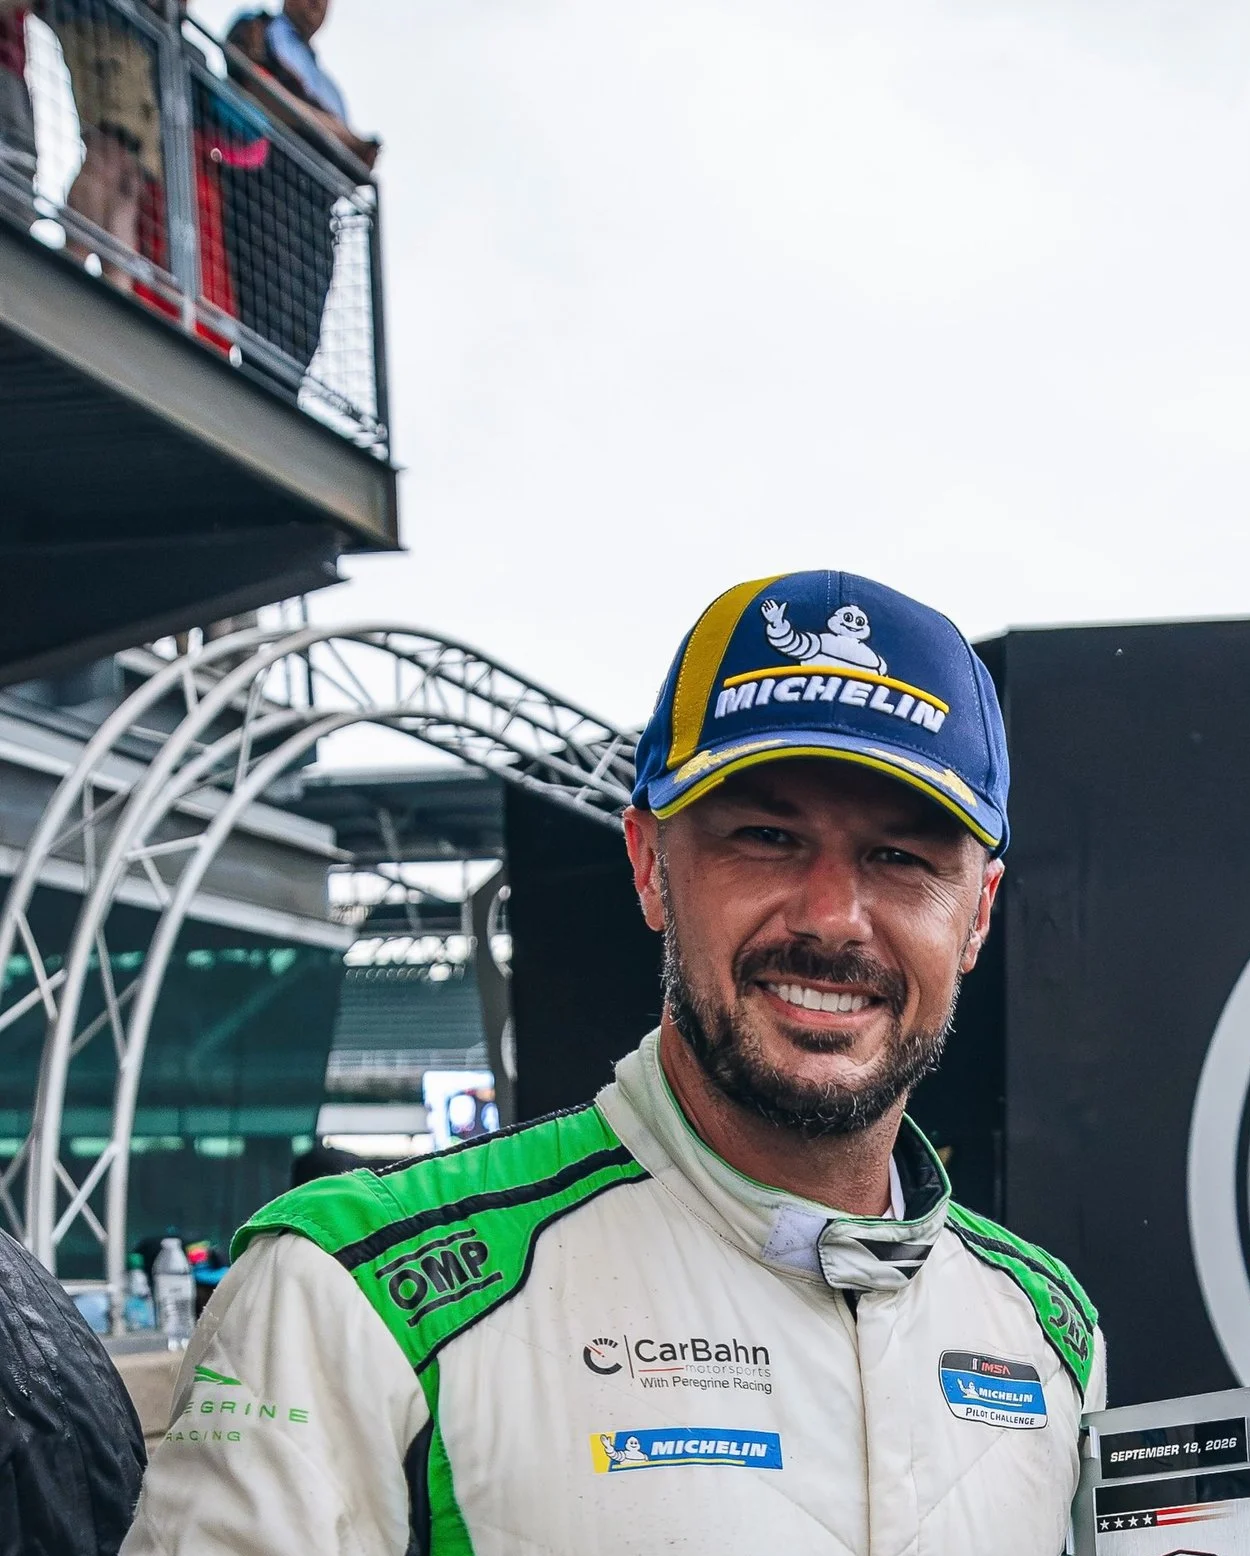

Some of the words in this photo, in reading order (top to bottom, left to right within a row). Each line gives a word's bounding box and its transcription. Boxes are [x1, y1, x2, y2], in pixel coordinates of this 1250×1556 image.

[714, 676, 947, 734] MICHELIN
[388, 1240, 489, 1311] OMP
[634, 1337, 771, 1366] CarBahn
[685, 1363, 772, 1378] motorsports
[981, 1362, 1011, 1375] IMSA
[640, 1376, 670, 1390] With
[672, 1376, 730, 1394] Peregrine
[733, 1378, 773, 1394] Racing
[979, 1387, 1033, 1403] MICHELIN
[966, 1407, 989, 1420] PILOT
[990, 1411, 1035, 1426] CHALLENGE
[651, 1439, 768, 1457] MICHELIN
[1110, 1444, 1180, 1463] SEPTEMBER
[1183, 1441, 1201, 1454] 19,
[1205, 1437, 1238, 1451] 2026
